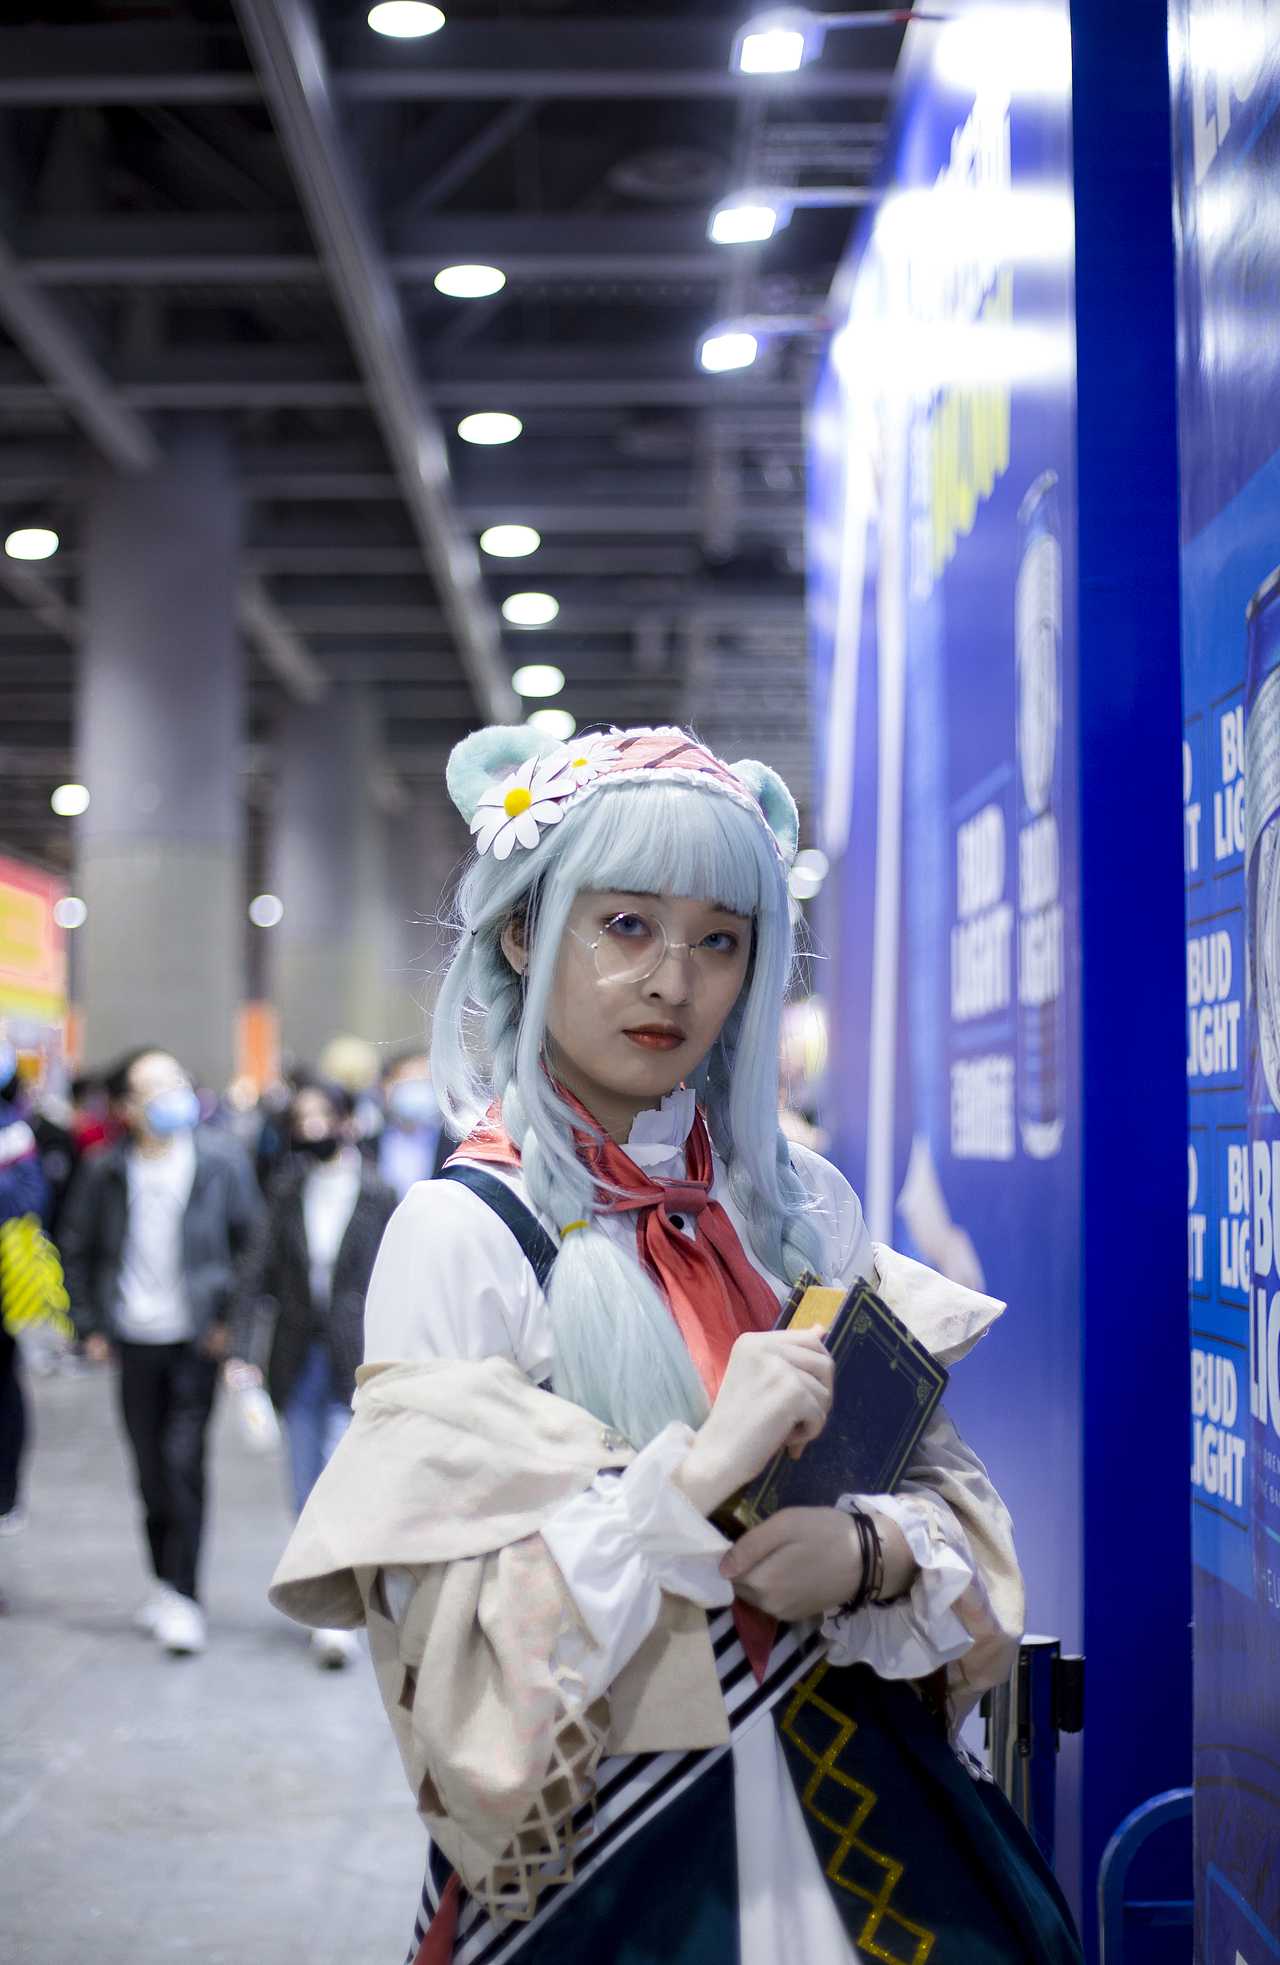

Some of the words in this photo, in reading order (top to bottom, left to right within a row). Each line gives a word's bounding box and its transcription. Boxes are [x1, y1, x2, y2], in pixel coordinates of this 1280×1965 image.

[1214, 777, 1246, 862] LIG
[1187, 930, 1232, 1008] BUD
[1186, 1000, 1241, 1077] IGHT
[1220, 1216, 1251, 1294] LIG
[1191, 1348, 1238, 1429] BUD
[1249, 1281, 1280, 1439] LIG
[1190, 1418, 1246, 1508] IGHT
